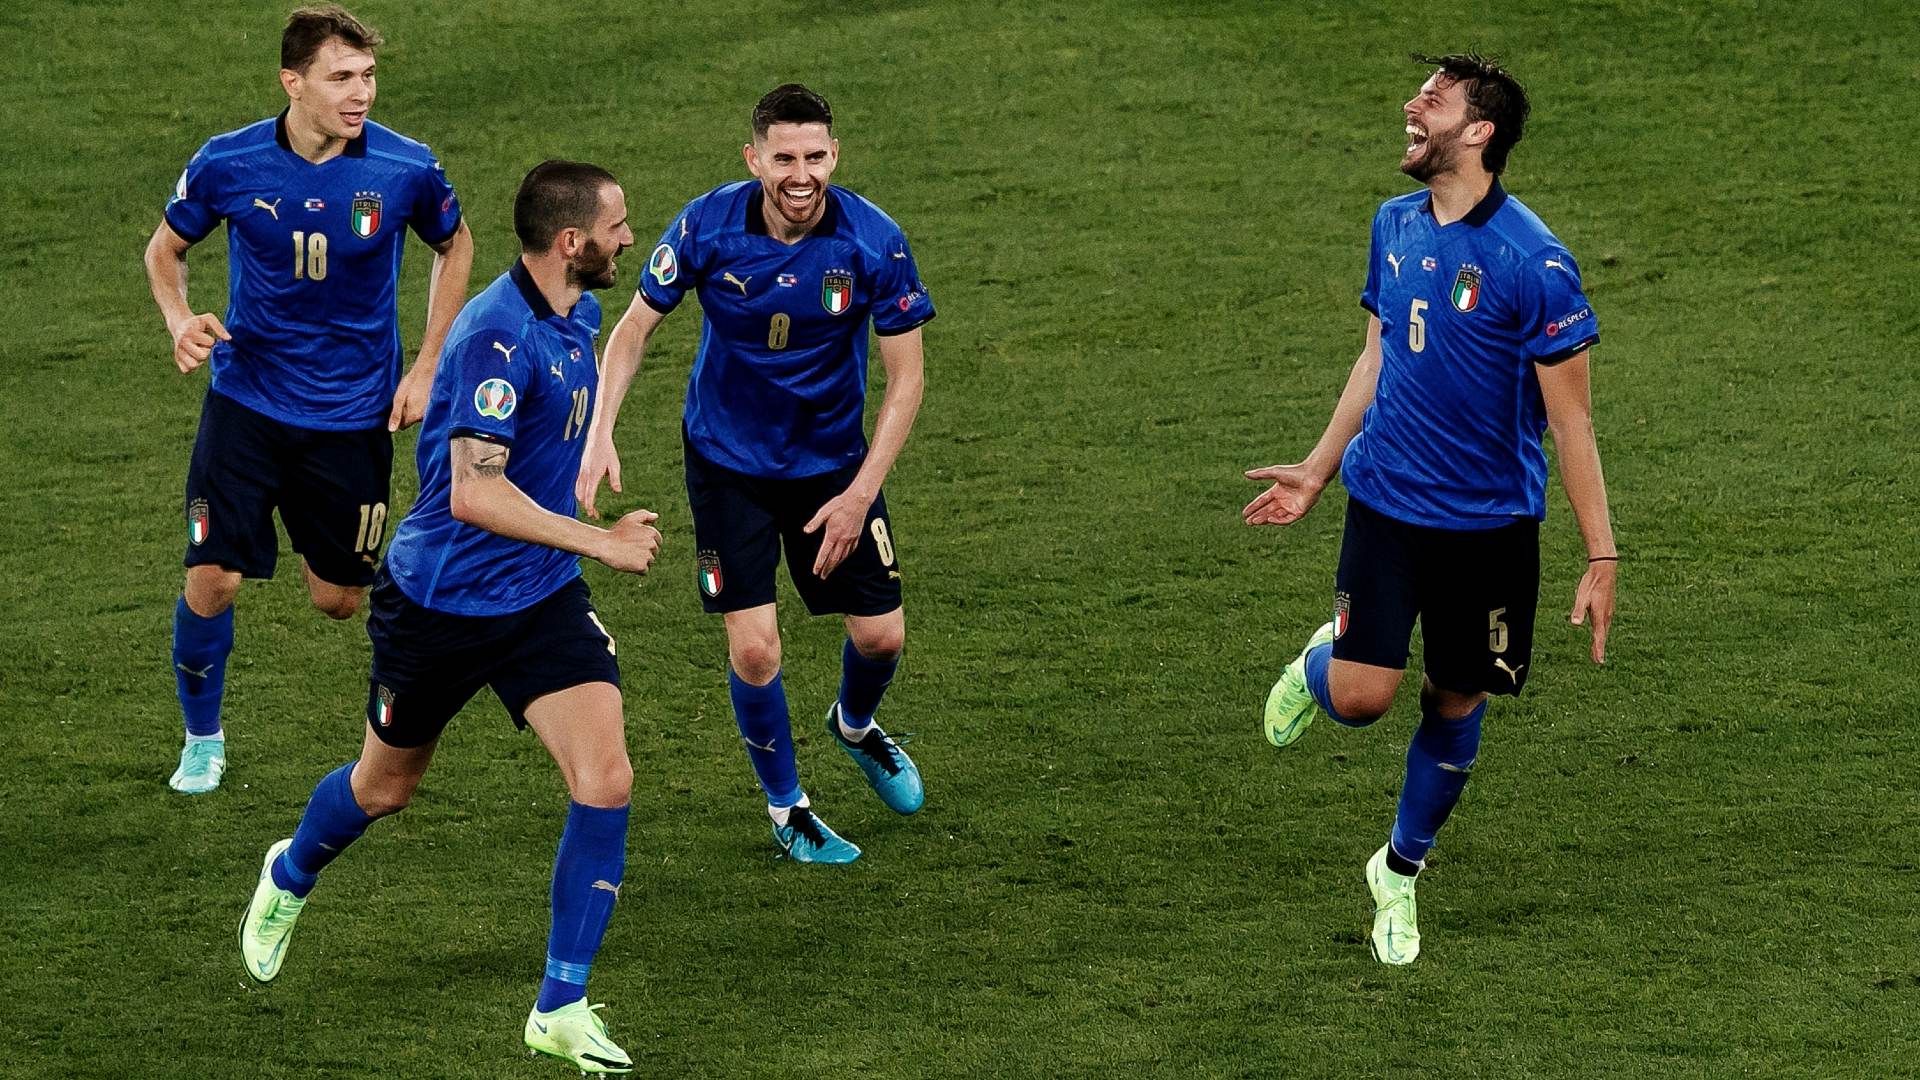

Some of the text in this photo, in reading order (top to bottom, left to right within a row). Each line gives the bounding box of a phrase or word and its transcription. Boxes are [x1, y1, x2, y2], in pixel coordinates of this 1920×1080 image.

[293, 230, 328, 281] 18
[768, 312, 791, 350] 8
[1409, 298, 1429, 353] 5
[1558, 308, 1589, 330] RESPECT
[564, 386, 589, 441] 19
[355, 502, 387, 553] 18
[870, 517, 895, 567] 8
[1489, 607, 1509, 653] 5
